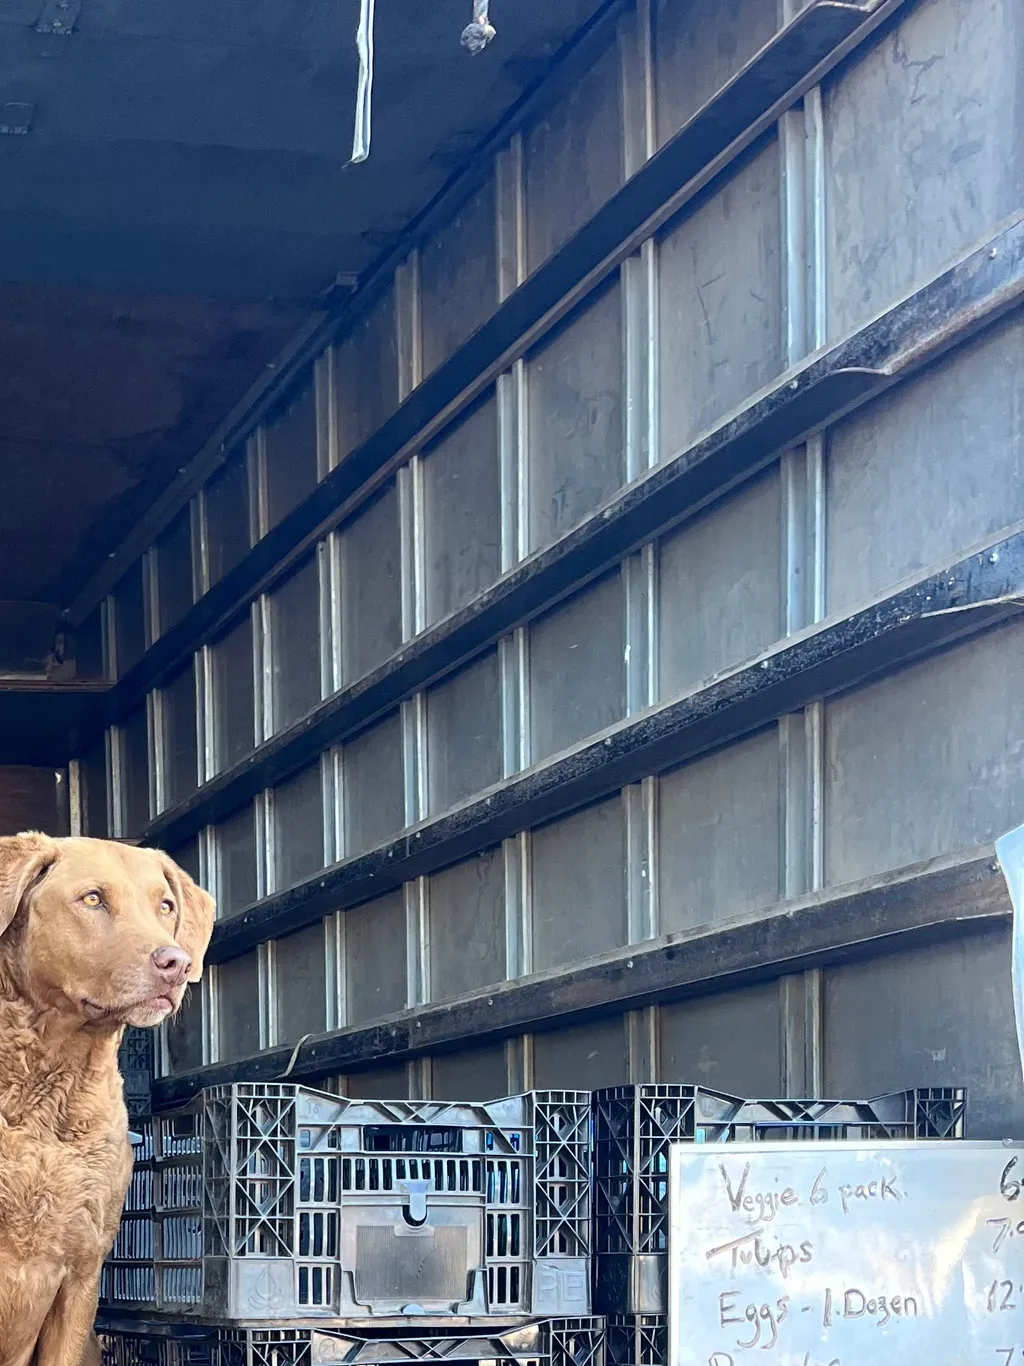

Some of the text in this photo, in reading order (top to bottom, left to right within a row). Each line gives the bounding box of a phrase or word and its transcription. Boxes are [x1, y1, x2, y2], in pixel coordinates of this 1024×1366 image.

[718, 1161, 799, 1225] Veggie
[809, 1166, 829, 1206] 6
[538, 1271, 585, 1302] PE
[719, 1291, 790, 1349] Eggs
[844, 1288, 918, 1327] Dozen
